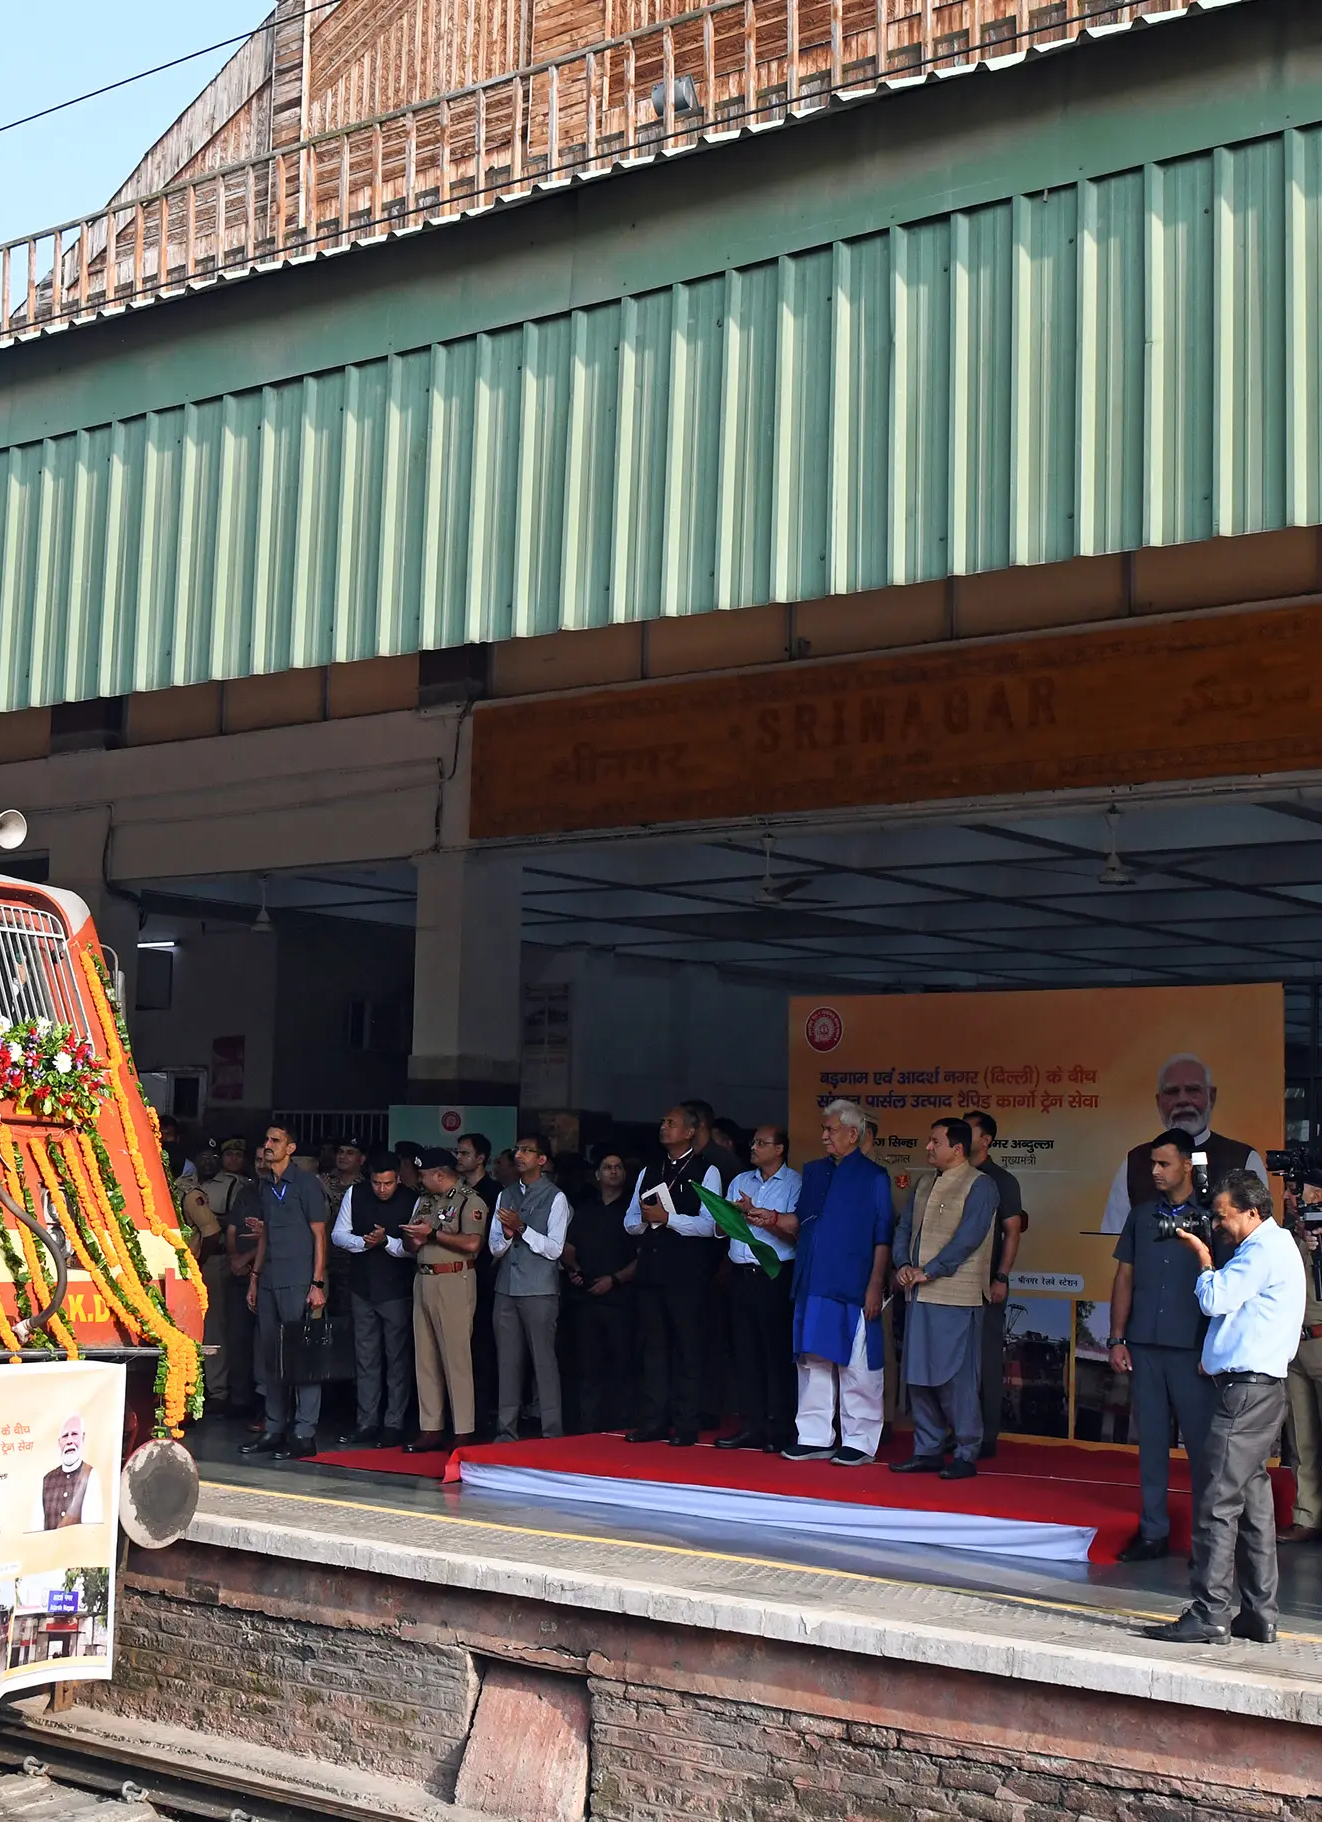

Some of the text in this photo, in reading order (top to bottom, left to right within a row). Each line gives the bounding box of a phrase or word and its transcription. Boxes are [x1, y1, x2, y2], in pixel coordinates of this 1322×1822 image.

[755, 675, 1059, 754] SRINAGAR
[820, 1064, 1098, 1089] बड़गाम एवं आदर्श नगर (दिल्ली) के बीच
[866, 1090, 908, 1108] पार्सल
[910, 1094, 953, 1108] उत्पाद
[958, 1090, 992, 1109] रैपिड
[996, 1090, 1037, 1108] कार्गो
[1040, 1090, 1064, 1114] ट्रेन
[1068, 1090, 1100, 1108] सेवा
[888, 1135, 918, 1148] सिन्हा
[1010, 1140, 1054, 1153] अब्दुल्ला
[1001, 1154, 1036, 1168] मुख्यमंत्री
[1018, 1276, 1038, 1285] श्रीनगर
[1042, 1276, 1055, 1286] रेलवे
[1058, 1277, 1078, 1287] स्टेशन
[2, 1424, 11, 1436] के
[14, 1423, 30, 1435] बीच
[1, 1441, 16, 1455] ट्रेन
[18, 1439, 34, 1452] सेवा
